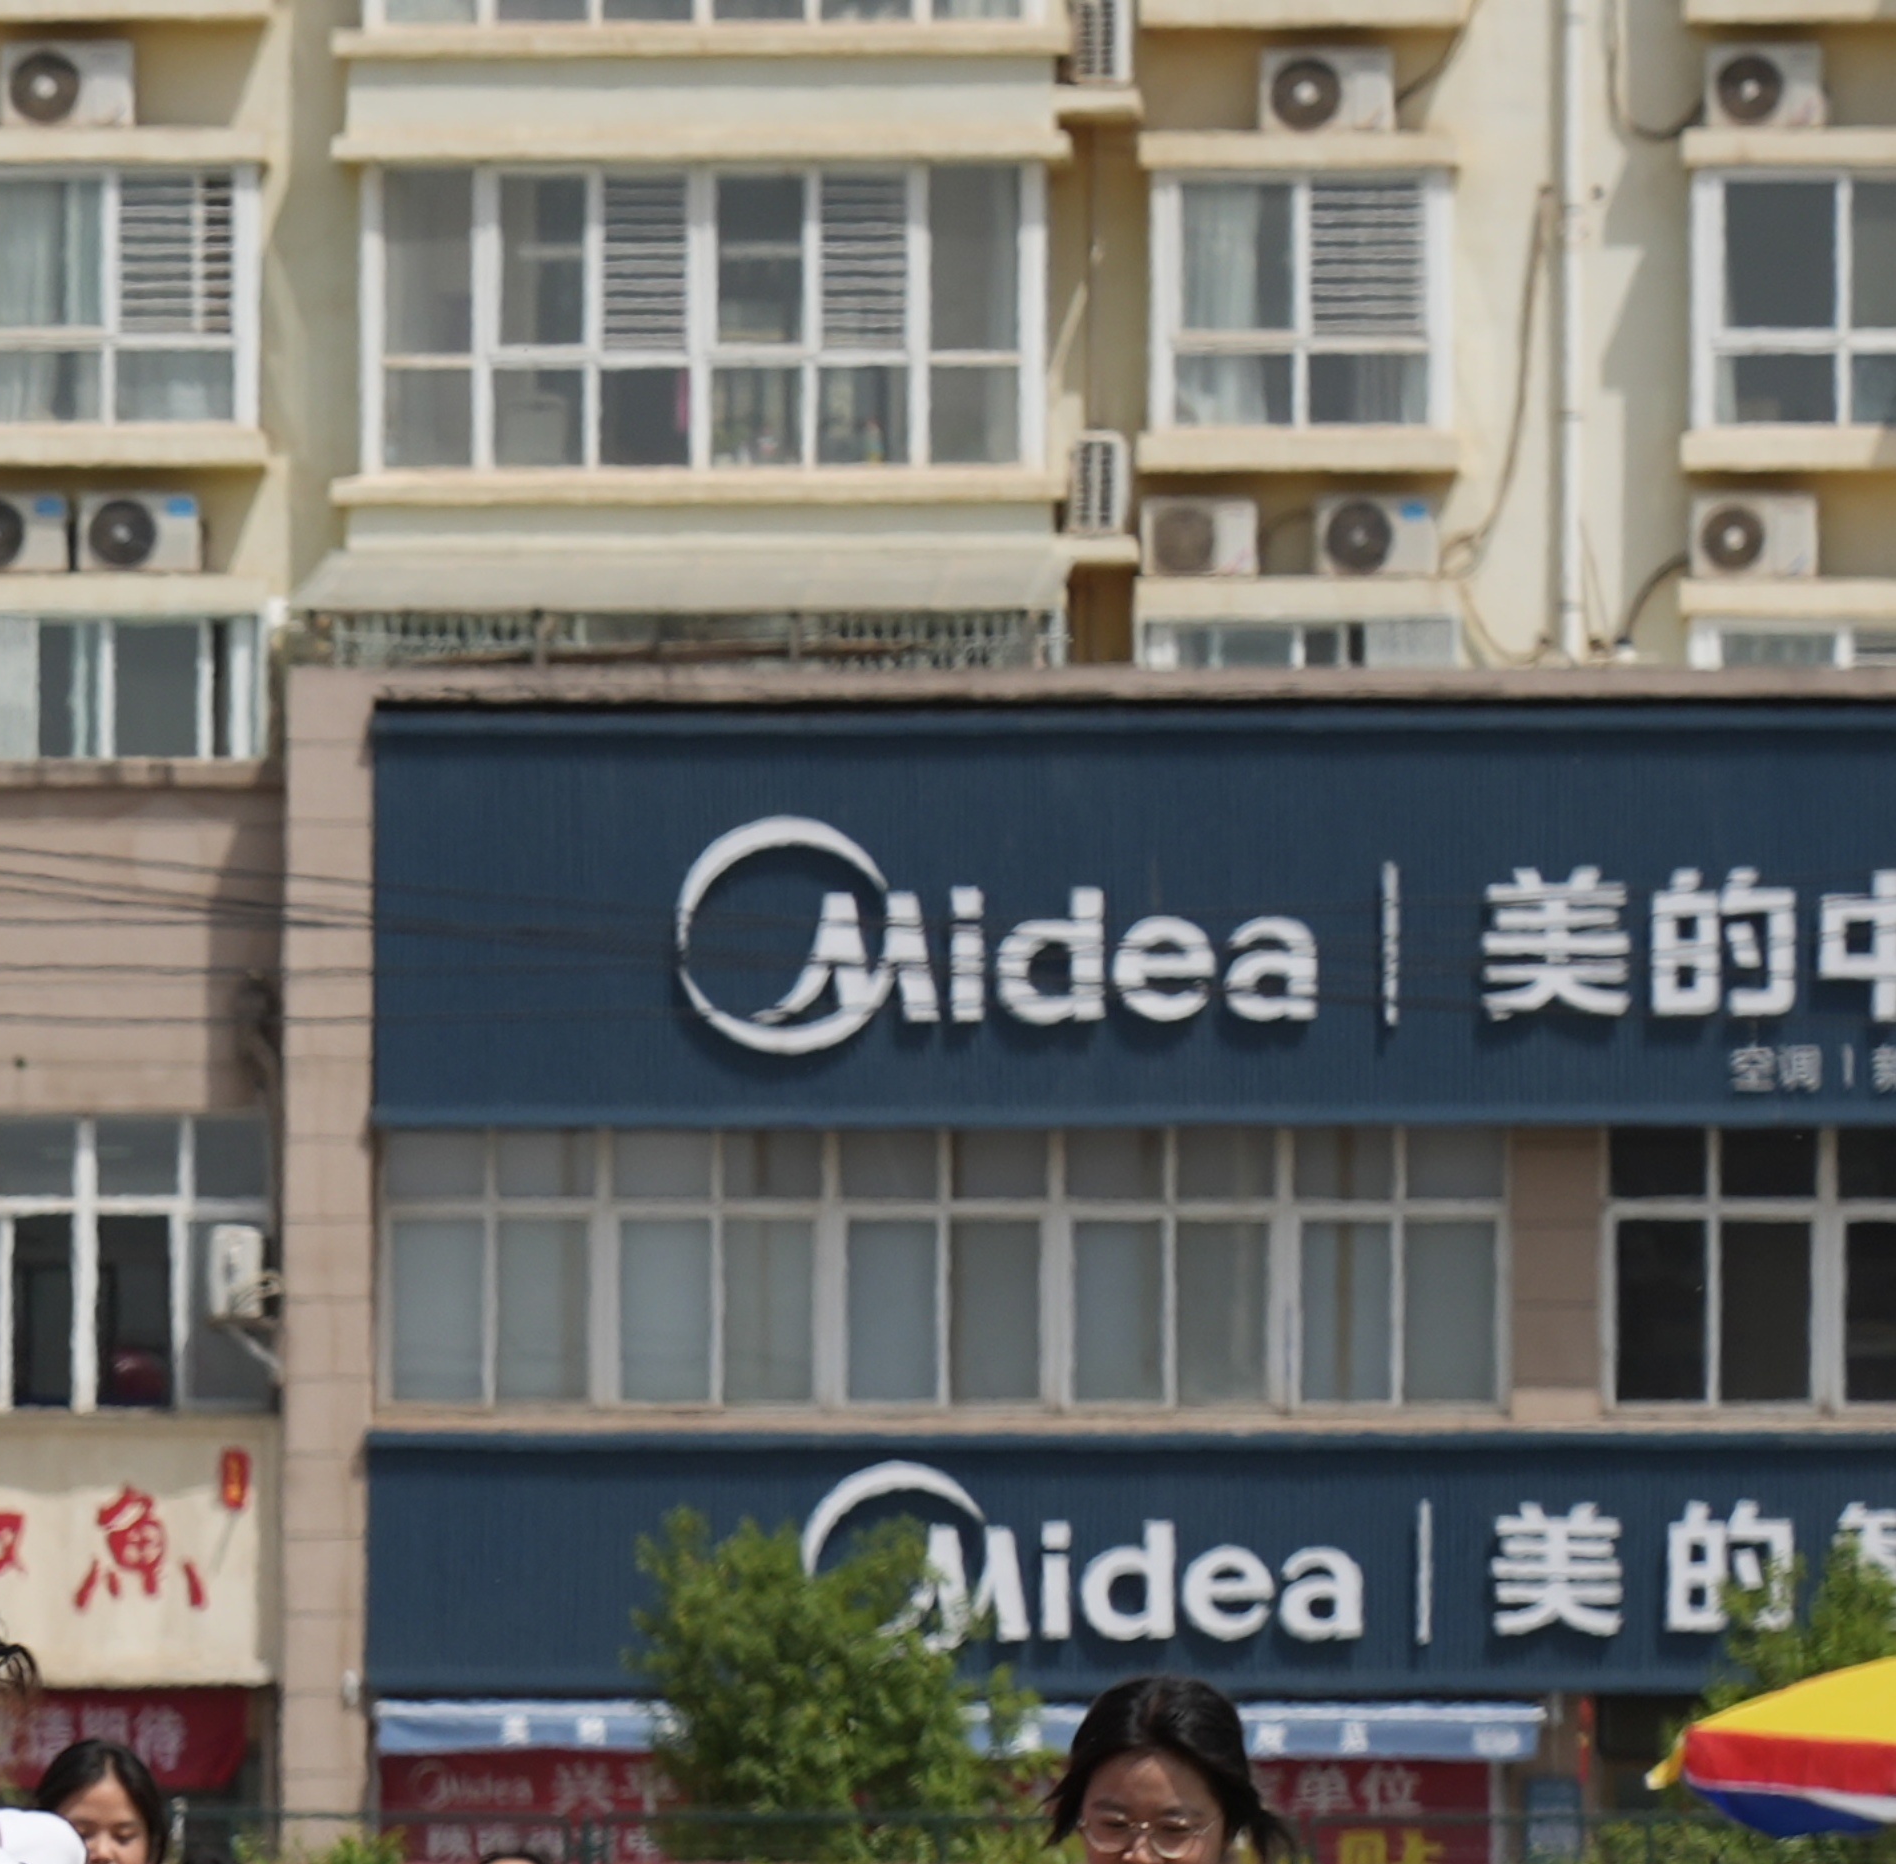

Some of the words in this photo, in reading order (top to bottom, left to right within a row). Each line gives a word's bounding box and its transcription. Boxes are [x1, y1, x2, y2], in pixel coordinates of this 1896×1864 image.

[745, 882, 1319, 1027] Midea
[1729, 1042, 1823, 1094] 空调
[877, 1517, 1364, 1655] Midea
